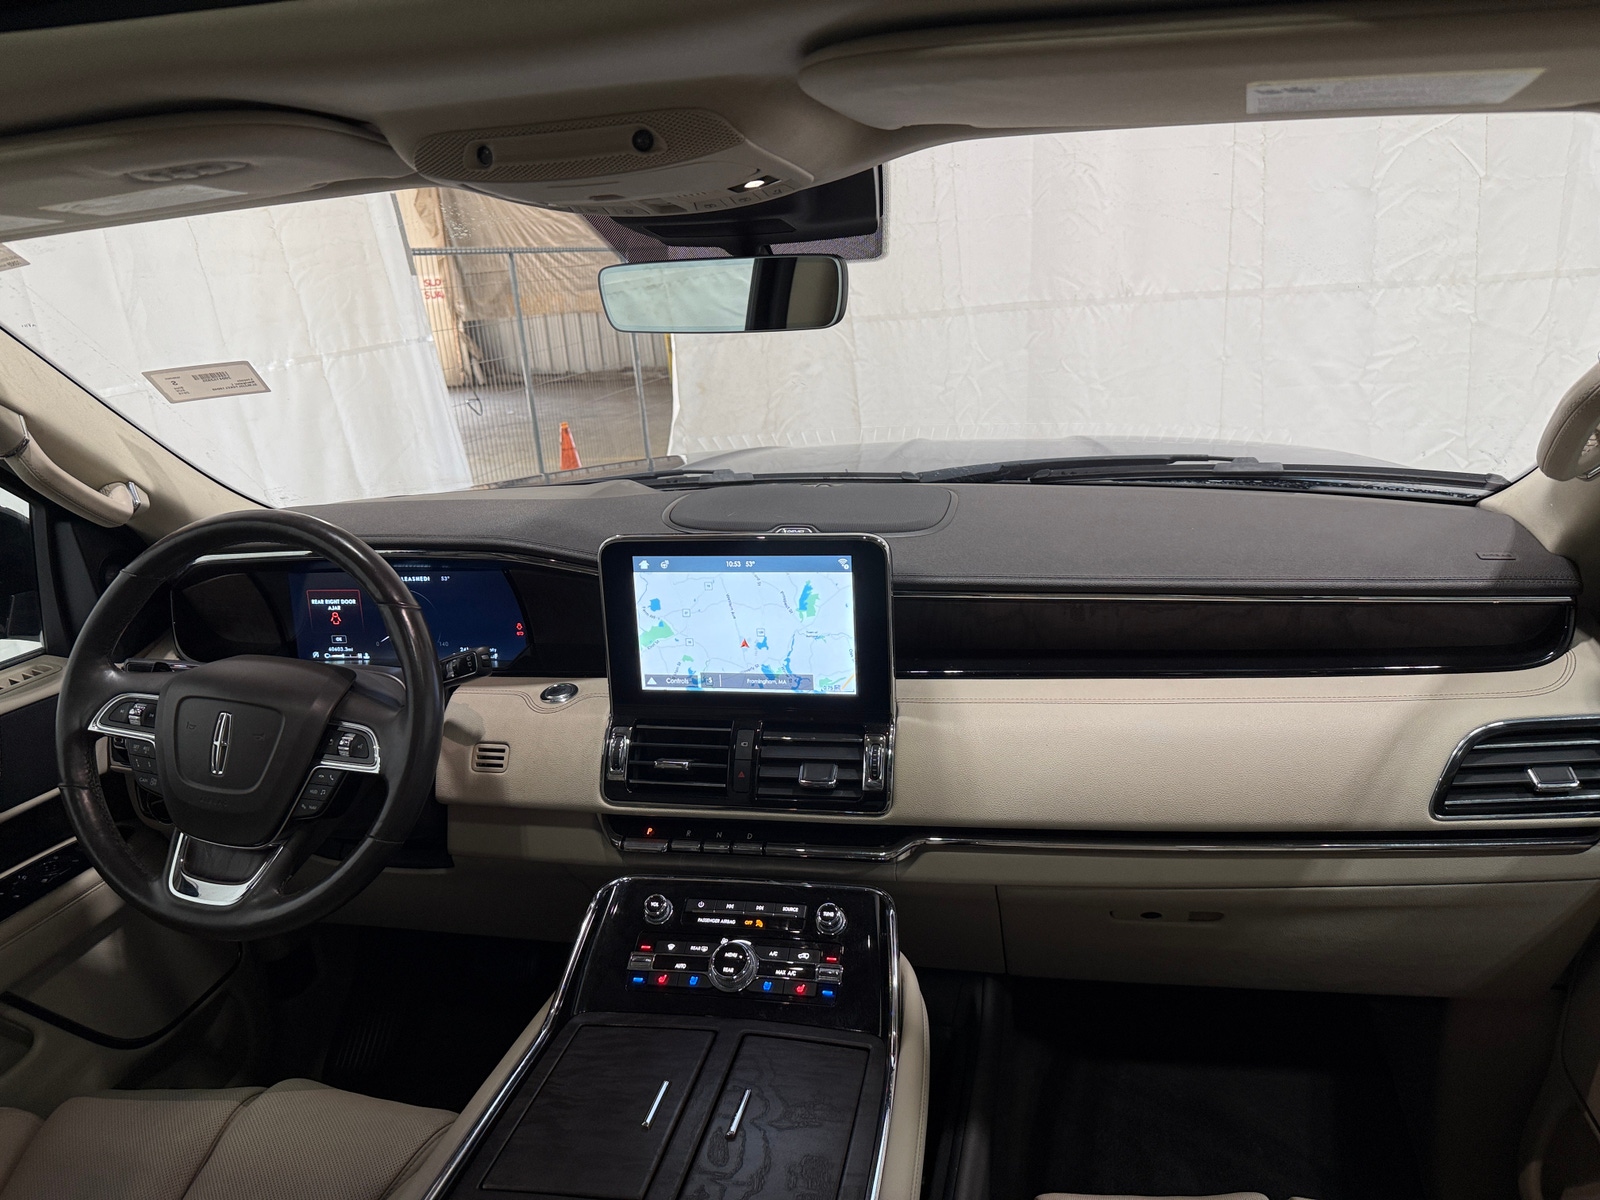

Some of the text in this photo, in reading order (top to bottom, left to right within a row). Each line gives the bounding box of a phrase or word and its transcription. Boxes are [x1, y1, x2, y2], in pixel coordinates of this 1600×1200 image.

[725, 560, 741, 568] 10:53
[665, 677, 689, 685] Controls
[646, 827, 653, 835] P
[686, 829, 692, 837] R
